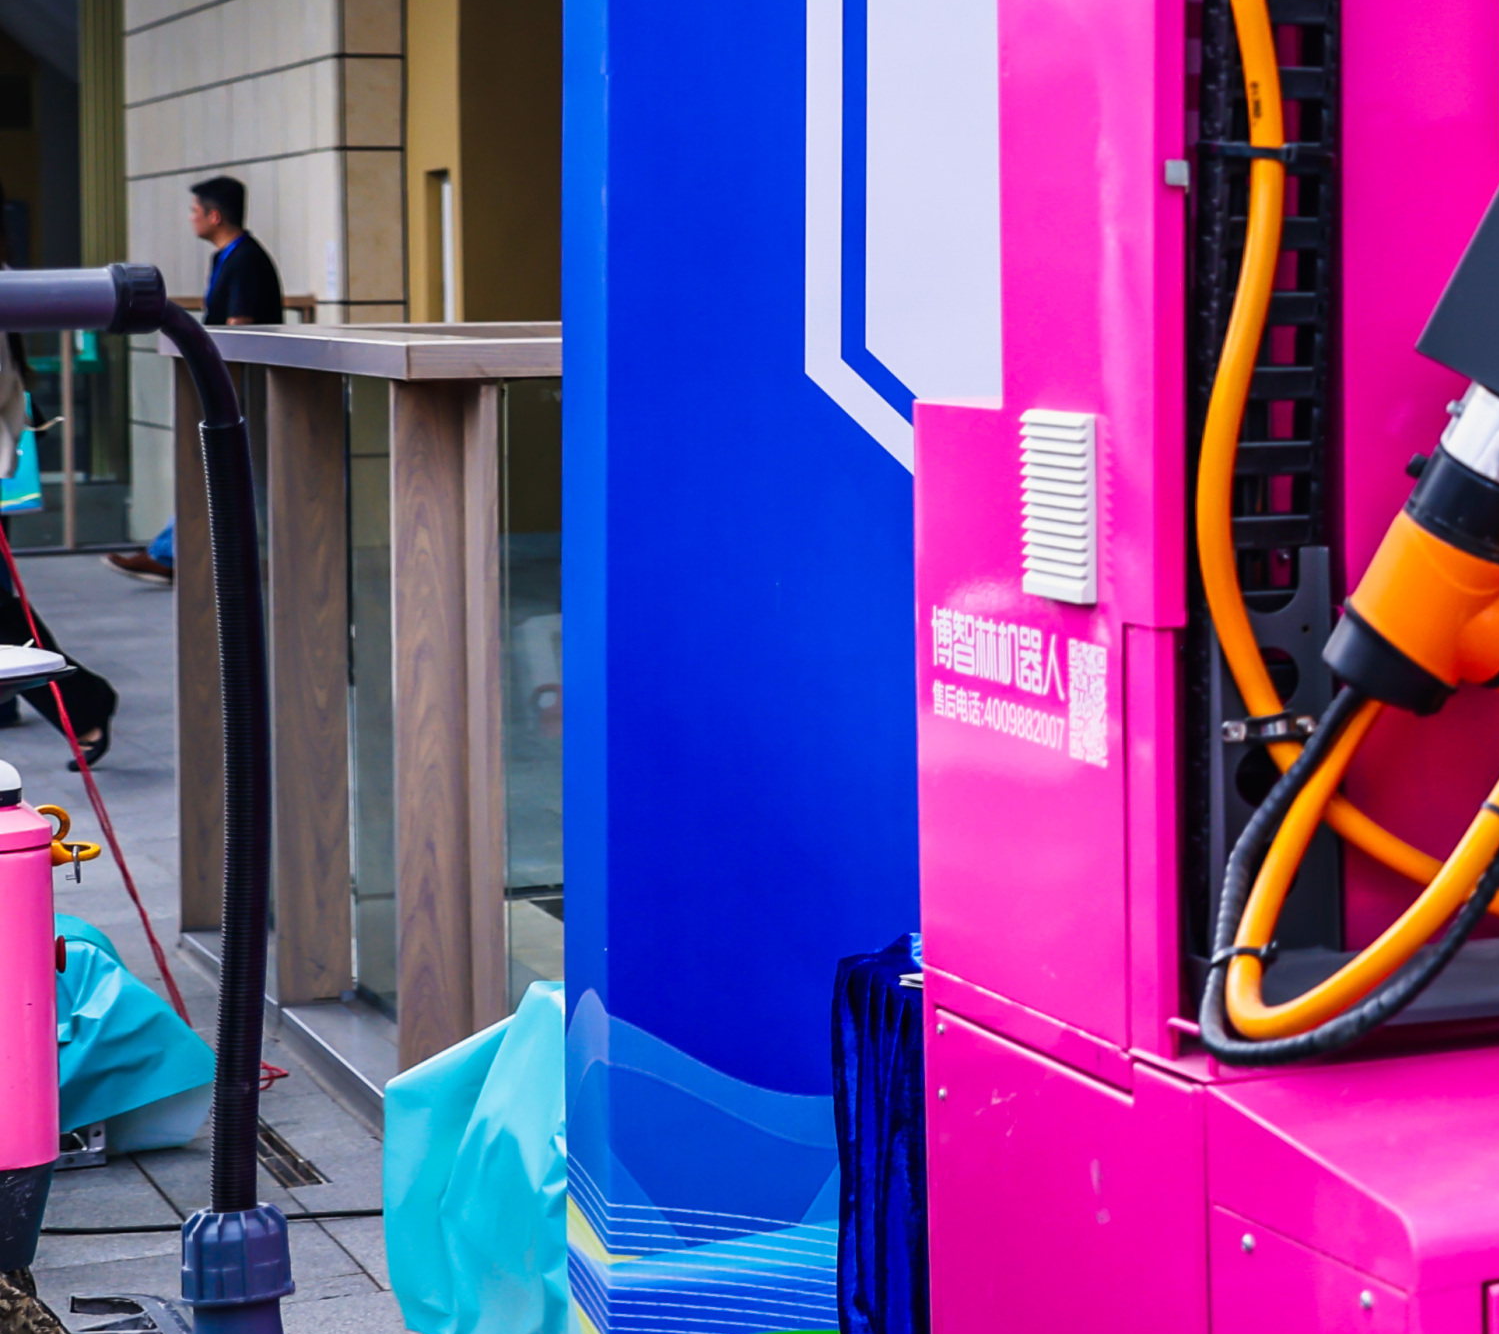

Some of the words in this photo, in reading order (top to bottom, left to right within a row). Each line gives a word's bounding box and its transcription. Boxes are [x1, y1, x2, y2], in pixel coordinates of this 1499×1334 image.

[931, 605, 1066, 701] 博智林机器人
